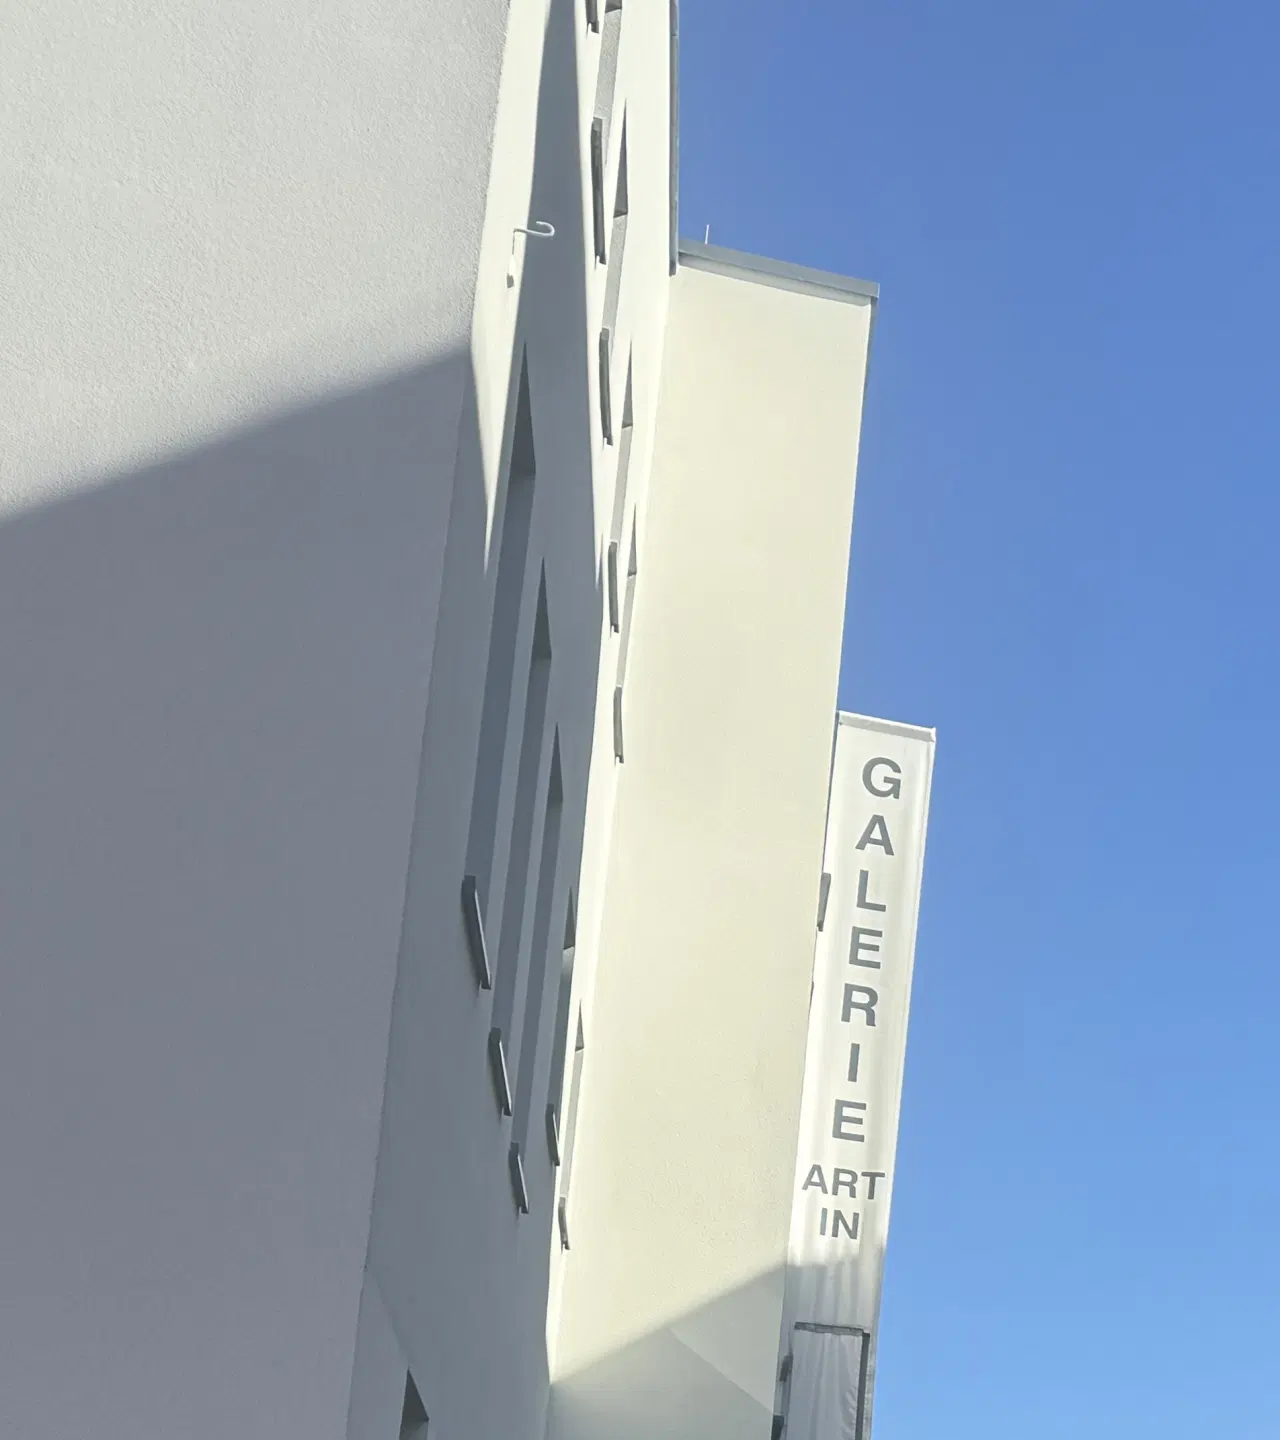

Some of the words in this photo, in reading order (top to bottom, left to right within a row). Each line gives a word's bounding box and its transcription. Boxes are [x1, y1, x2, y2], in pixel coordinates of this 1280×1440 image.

[831, 756, 902, 1143] GALERIE
[801, 1163, 886, 1202] ART
[819, 1206, 861, 1241] IN
